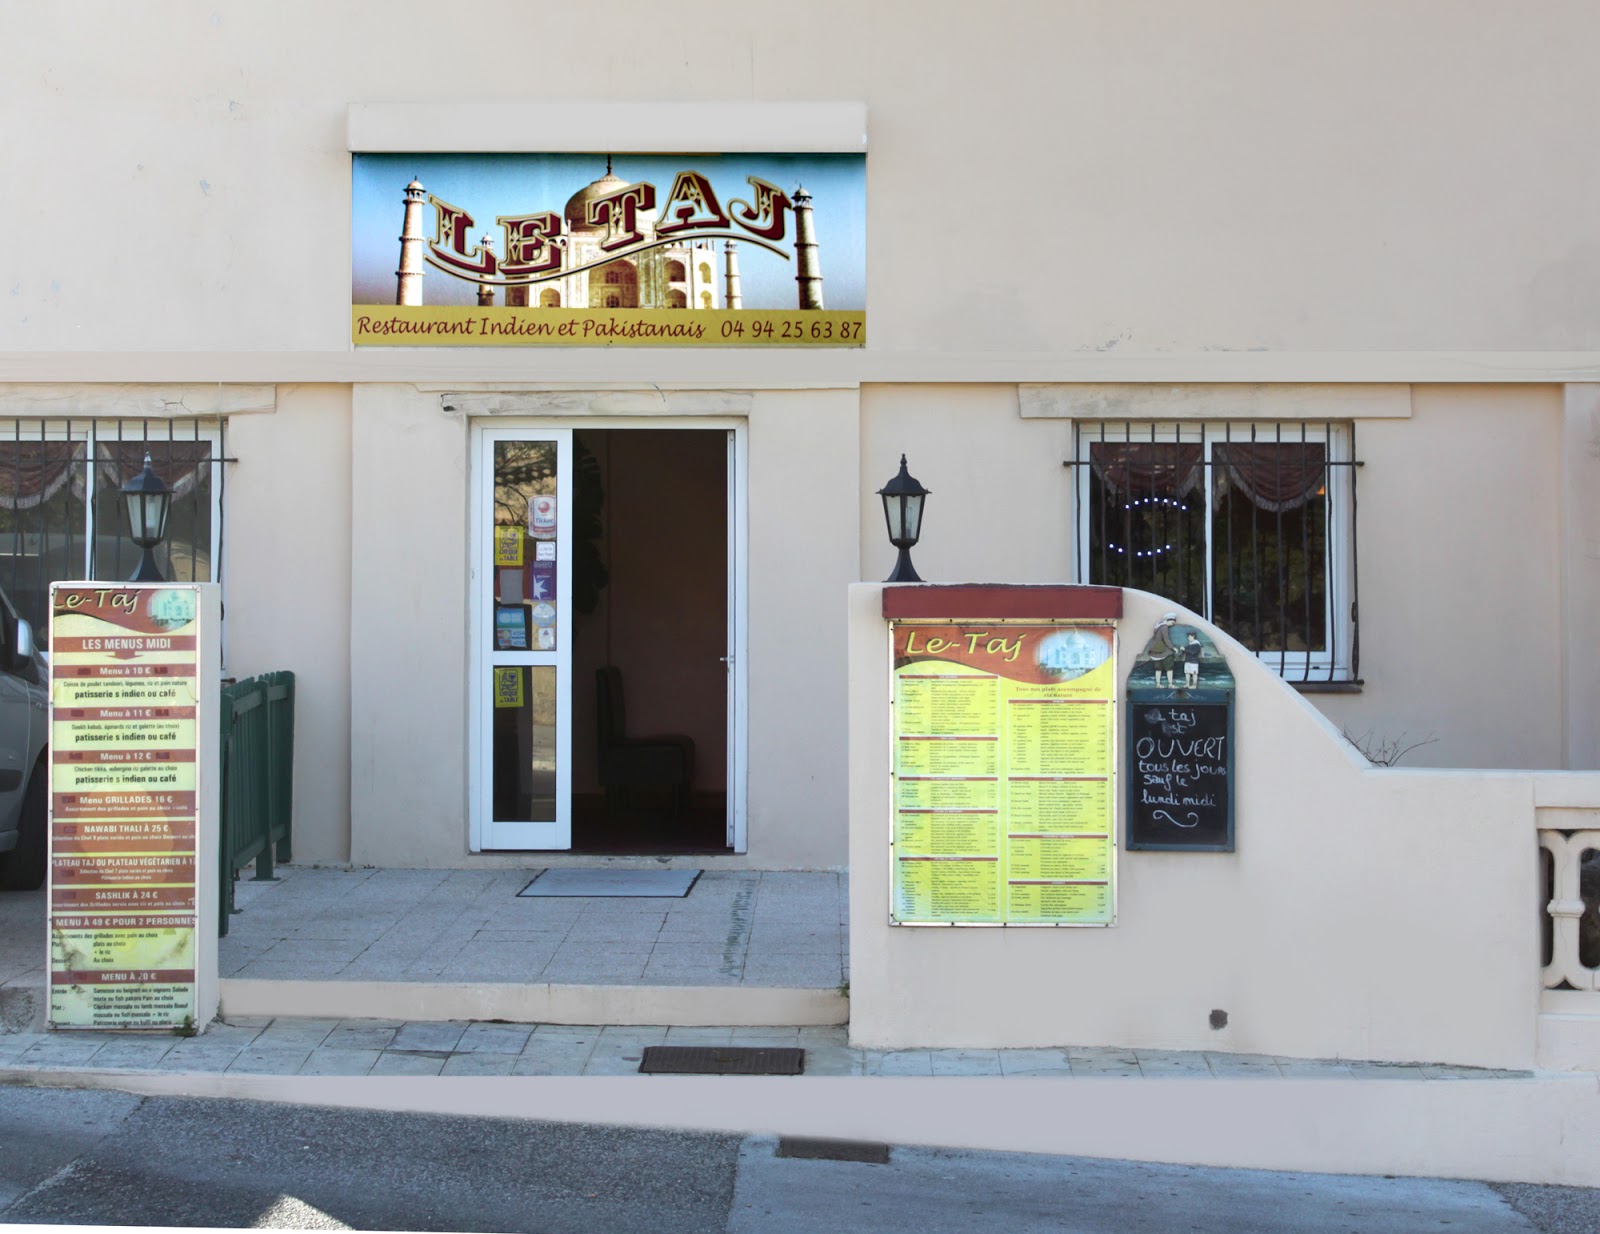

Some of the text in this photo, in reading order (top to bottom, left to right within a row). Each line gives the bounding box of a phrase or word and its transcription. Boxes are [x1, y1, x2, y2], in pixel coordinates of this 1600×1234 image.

[428, 170, 793, 277] LE TAJ
[358, 316, 862, 339] Restaurant Indien et Pakistanais 04 94 25 63 87
[82, 638, 170, 650] LES MENUS MIDI
[906, 631, 1027, 662] Le-Taj
[75, 690, 113, 700] patisserie
[122, 689, 145, 698] indien
[159, 689, 176, 697] café
[126, 709, 130, 717] à
[134, 709, 142, 717] 11
[76, 733, 113, 742] patisserie
[122, 732, 145, 741] indien
[159, 732, 176, 740] café
[1136, 736, 1225, 760] OUVERT
[100, 752, 123, 760] Menu
[126, 752, 130, 760] à
[1138, 760, 1169, 772] tous
[1172, 759, 1190, 773] les
[76, 775, 113, 785] patisserie
[122, 775, 146, 783] indien
[160, 774, 176, 782] café
[1140, 788, 1216, 806] lundi midi
[144, 823, 149, 832] À
[108, 858, 138, 866] PLATEAU
[140, 857, 180, 865] VÉGÉTARIEN
[182, 856, 187, 865] À
[133, 890, 138, 898] À
[56, 918, 81, 926] MENU
[84, 917, 89, 926] À
[92, 918, 102, 926] 49
[113, 918, 136, 926] POUR
[146, 917, 195, 925] PERSONNES
[130, 972, 135, 980] À
